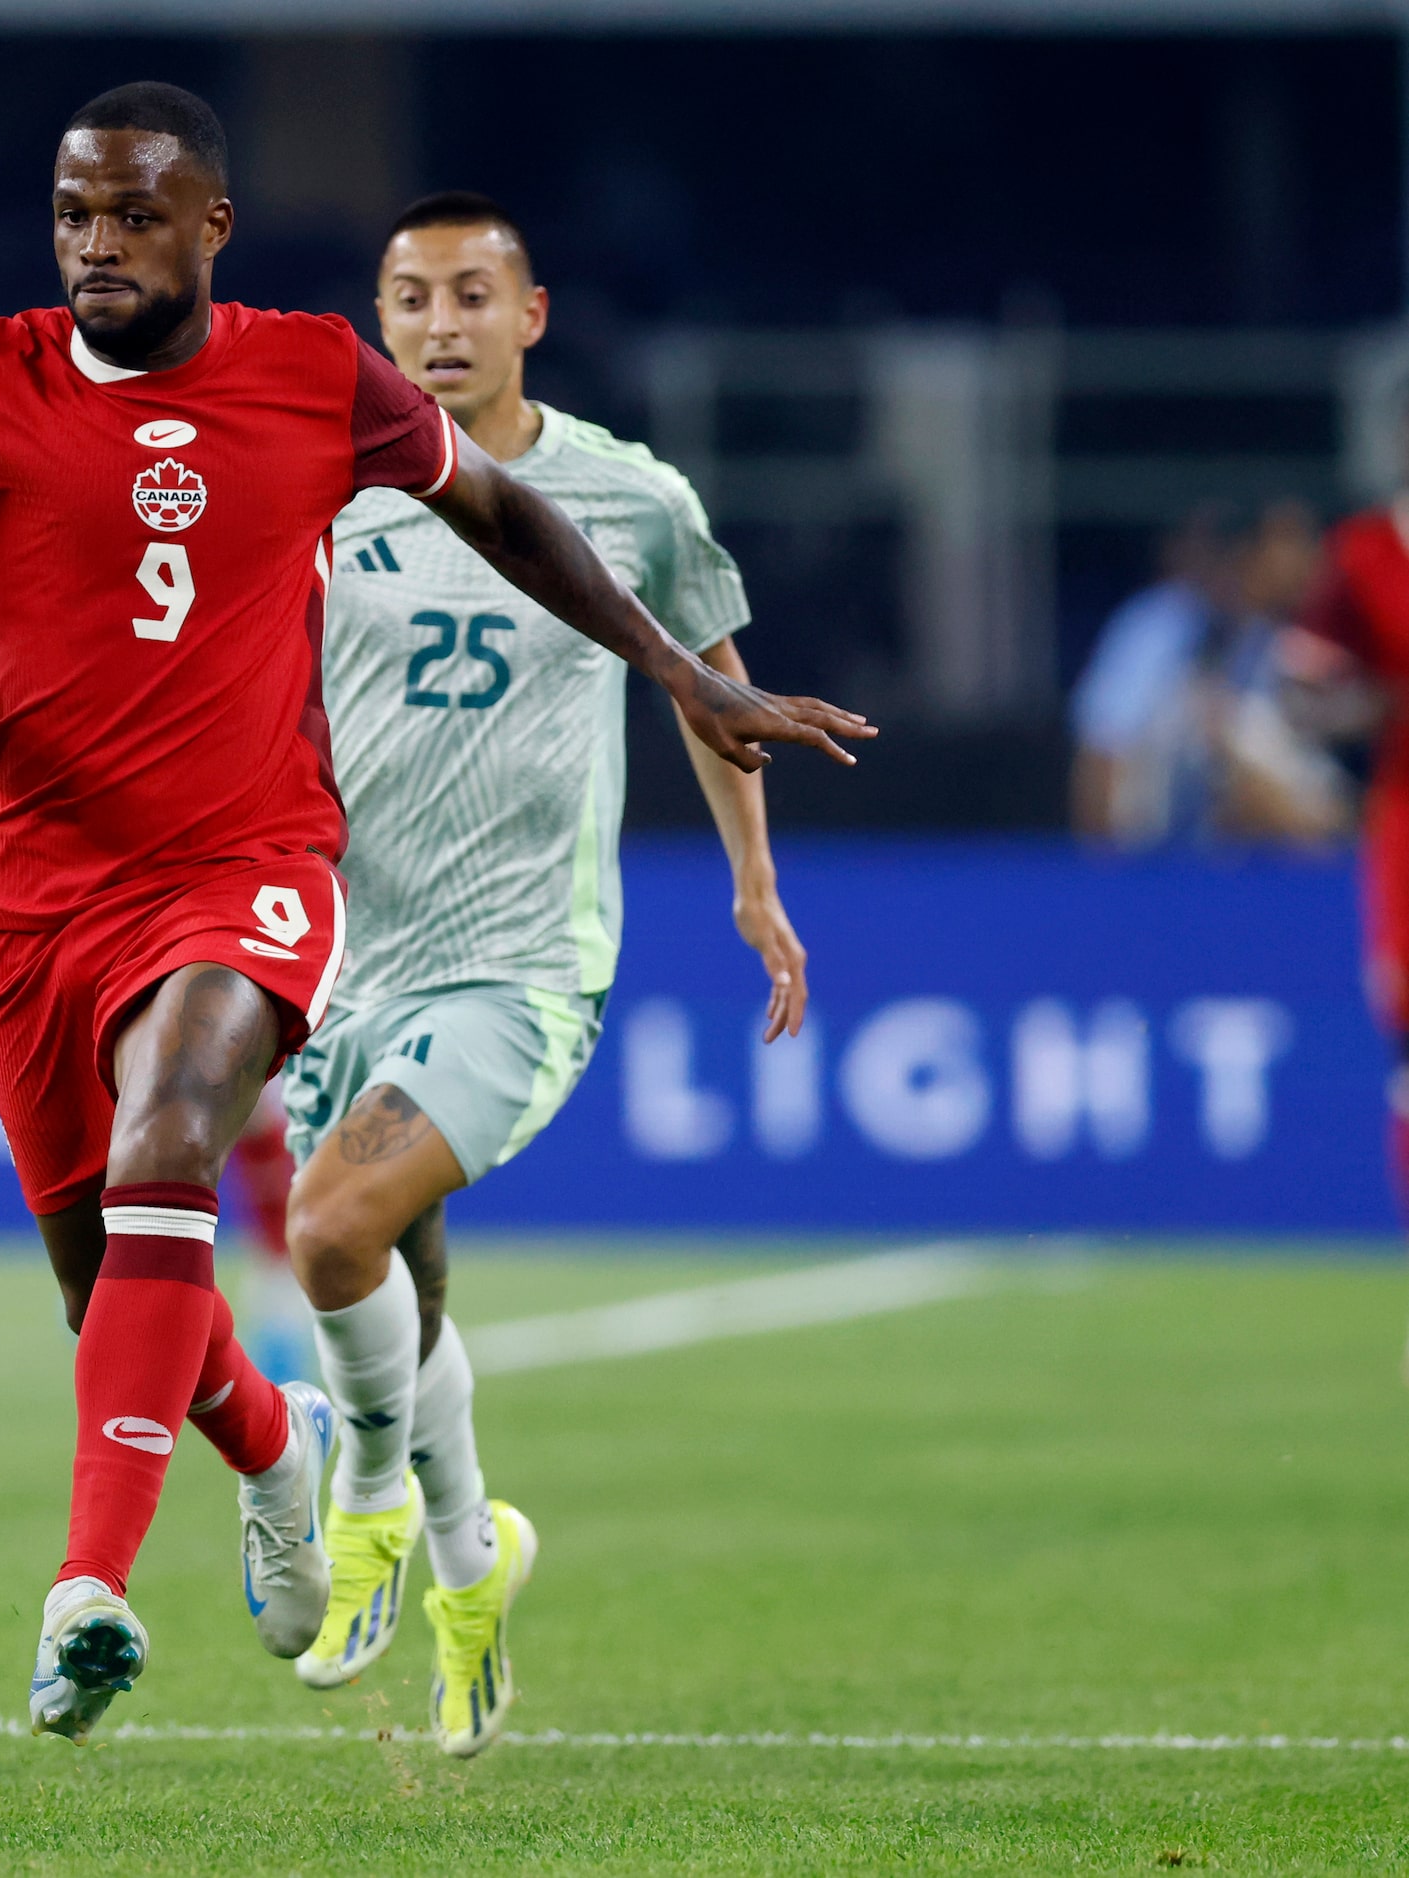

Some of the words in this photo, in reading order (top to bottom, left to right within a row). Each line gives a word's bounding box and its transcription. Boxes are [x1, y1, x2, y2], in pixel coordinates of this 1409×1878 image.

[135, 490, 203, 503] CANADA
[131, 541, 196, 642] 9
[404, 609, 517, 709] 25
[250, 884, 312, 948] 9
[624, 998, 1292, 1160] LIGHT
